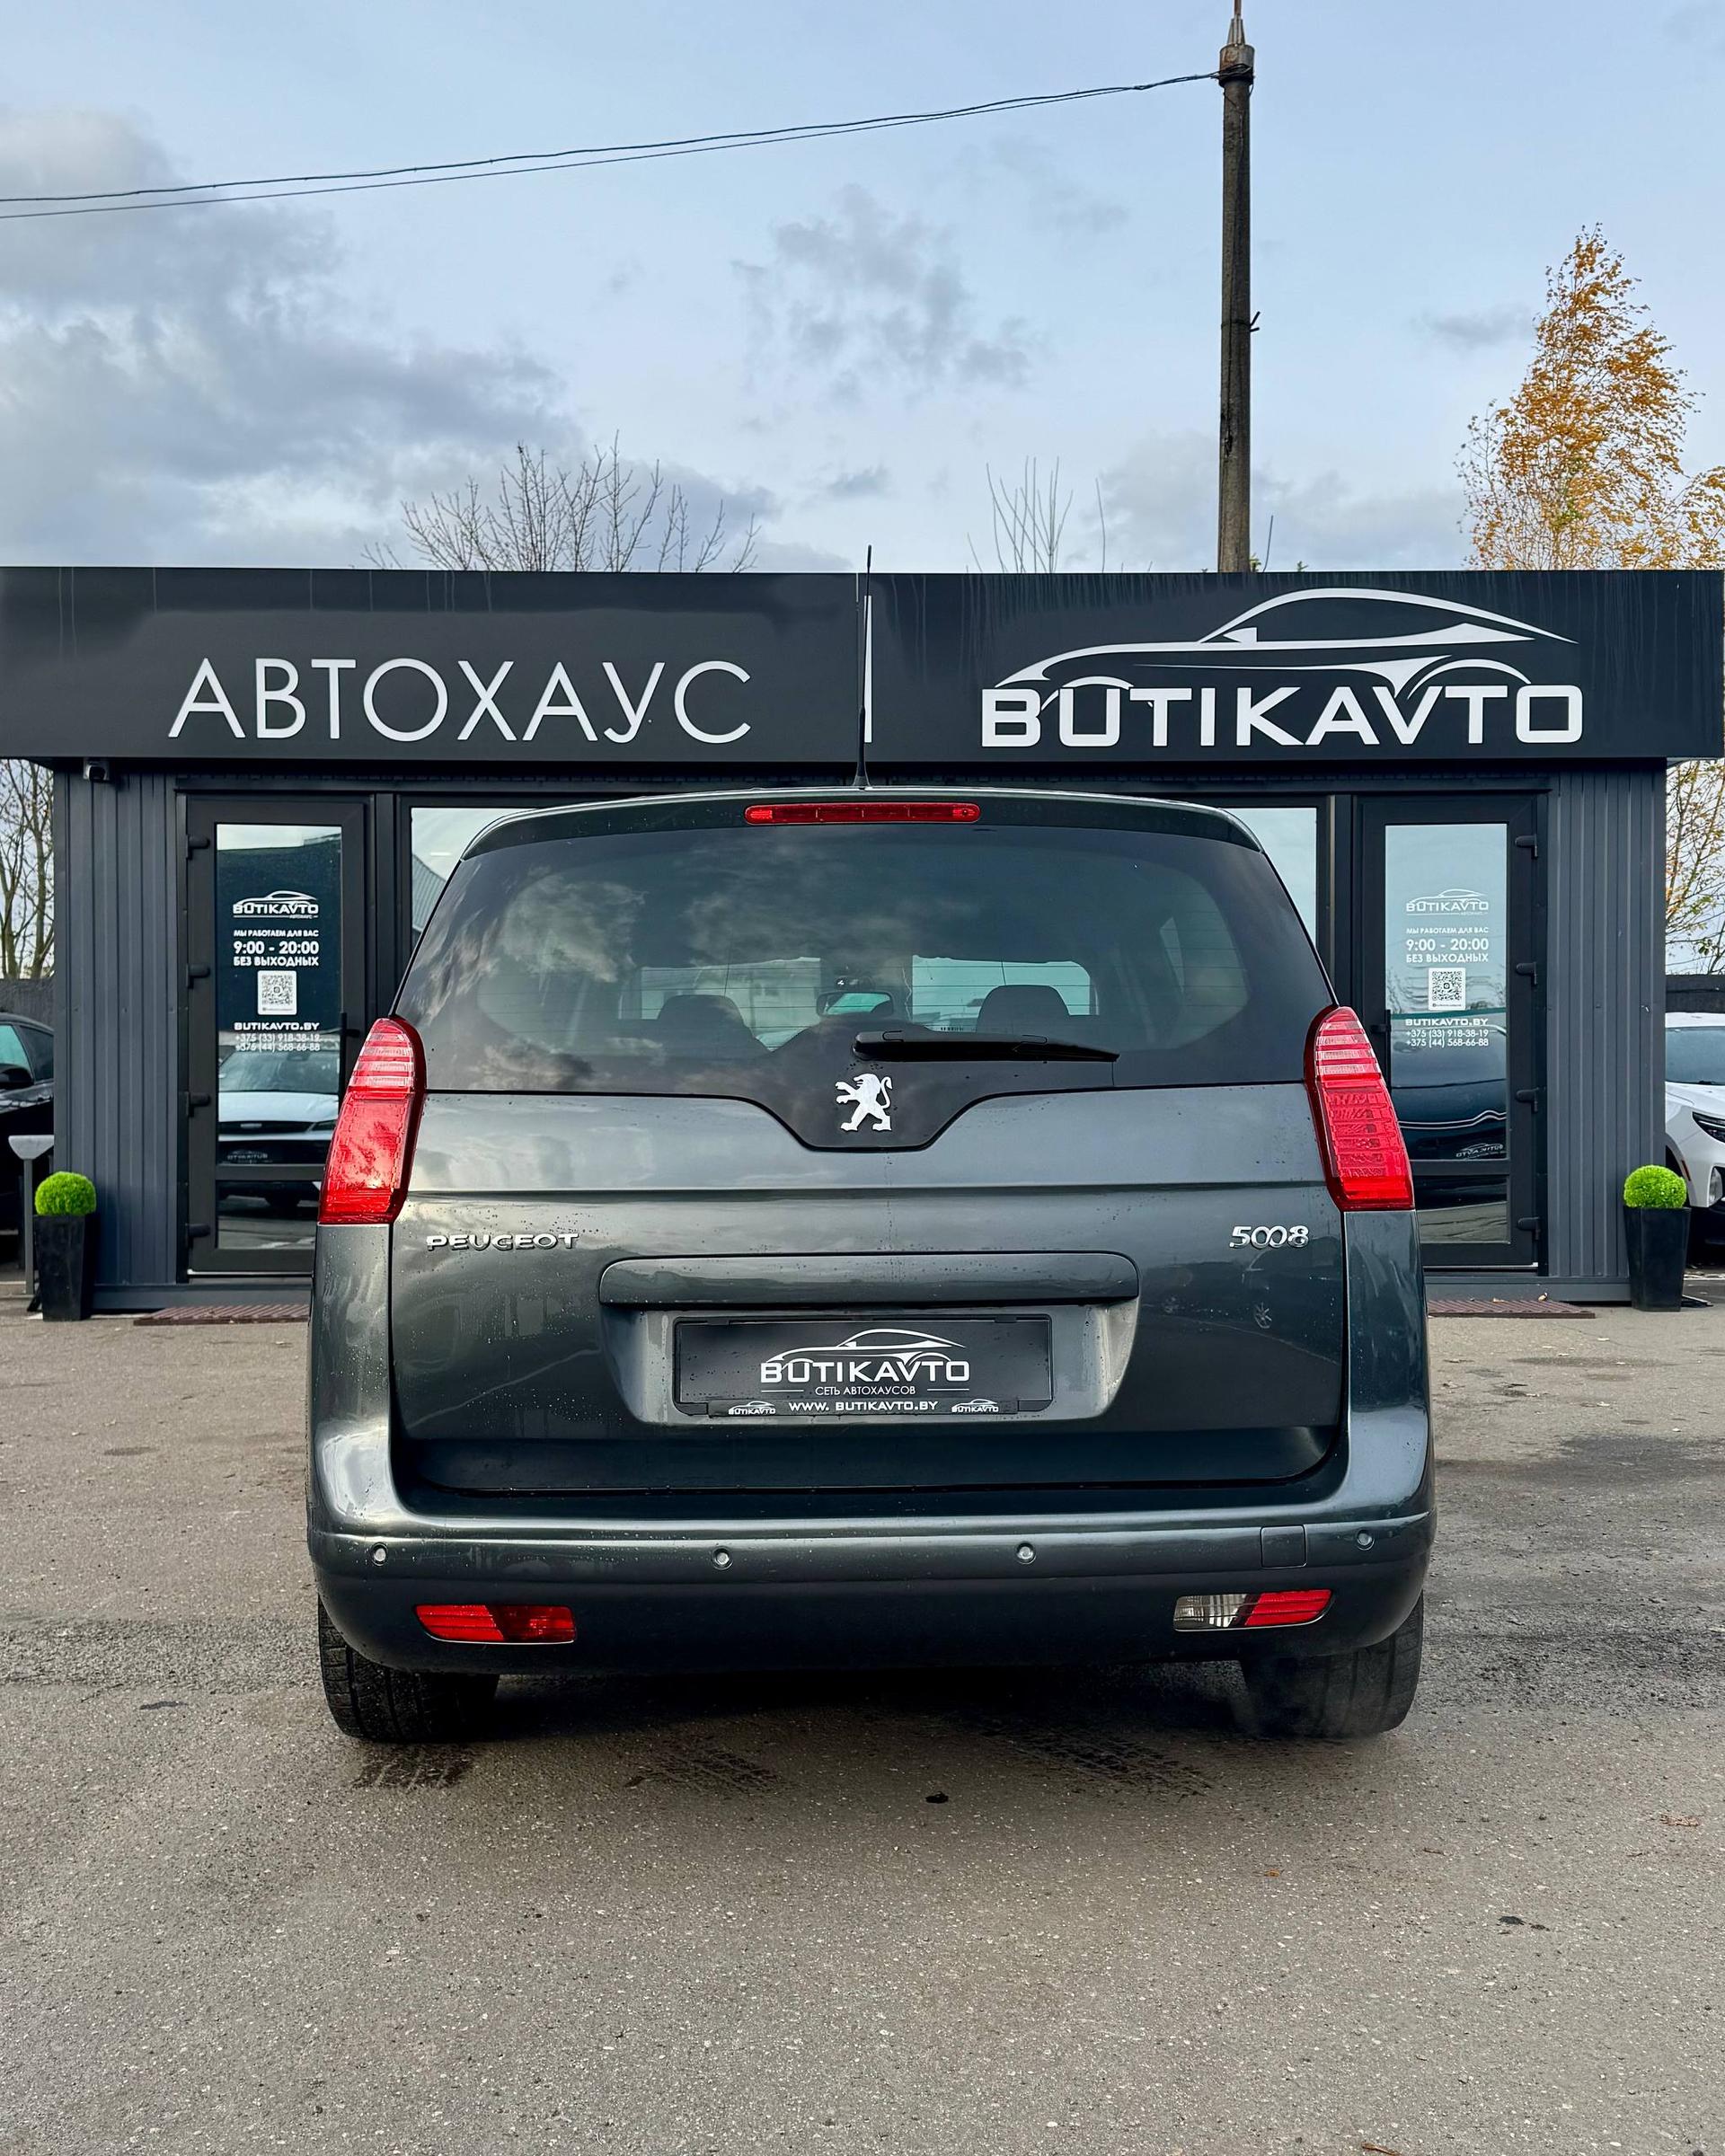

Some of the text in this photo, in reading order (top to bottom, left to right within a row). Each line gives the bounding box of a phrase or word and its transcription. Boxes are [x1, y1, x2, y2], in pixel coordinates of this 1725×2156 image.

[168, 658, 751, 744] АВТОХАУС
[981, 685, 1584, 747] BUTIKAVTO
[233, 903, 319, 915] BUTIKAVTO
[1406, 900, 1489, 912] BUTIKAVTO
[234, 941, 265, 954] 9:00
[279, 941, 320, 954] 20:00
[1406, 939, 1436, 951] 9:00
[1450, 938, 1489, 950] 20:00
[234, 957, 319, 968] БЕЗ ВЫХОДНЫХ
[1406, 953, 1489, 963] БЕЗ ВЫХОДНЫХ
[234, 1022, 320, 1030] BUTIKAVTO.BY
[1405, 1018, 1489, 1026] BUTIKAVTO.BY
[235, 1033, 256, 1042] +375
[259, 1033, 276, 1043] (33)
[1406, 1029, 1489, 1039] +375 (33) 918-38-19
[259, 1042, 276, 1053] (44)
[1406, 1038, 1489, 1048] +375 (44) 568-66-88
[426, 1233, 579, 1251] PEUGEOT
[1229, 1224, 1309, 1250] 5008
[760, 1360, 970, 1383] BUTIKAVTO
[815, 1385, 916, 1396] СЕТЬ АВТОХАУСОВ
[836, 1401, 938, 1411] BUTIKAVTO.BY
